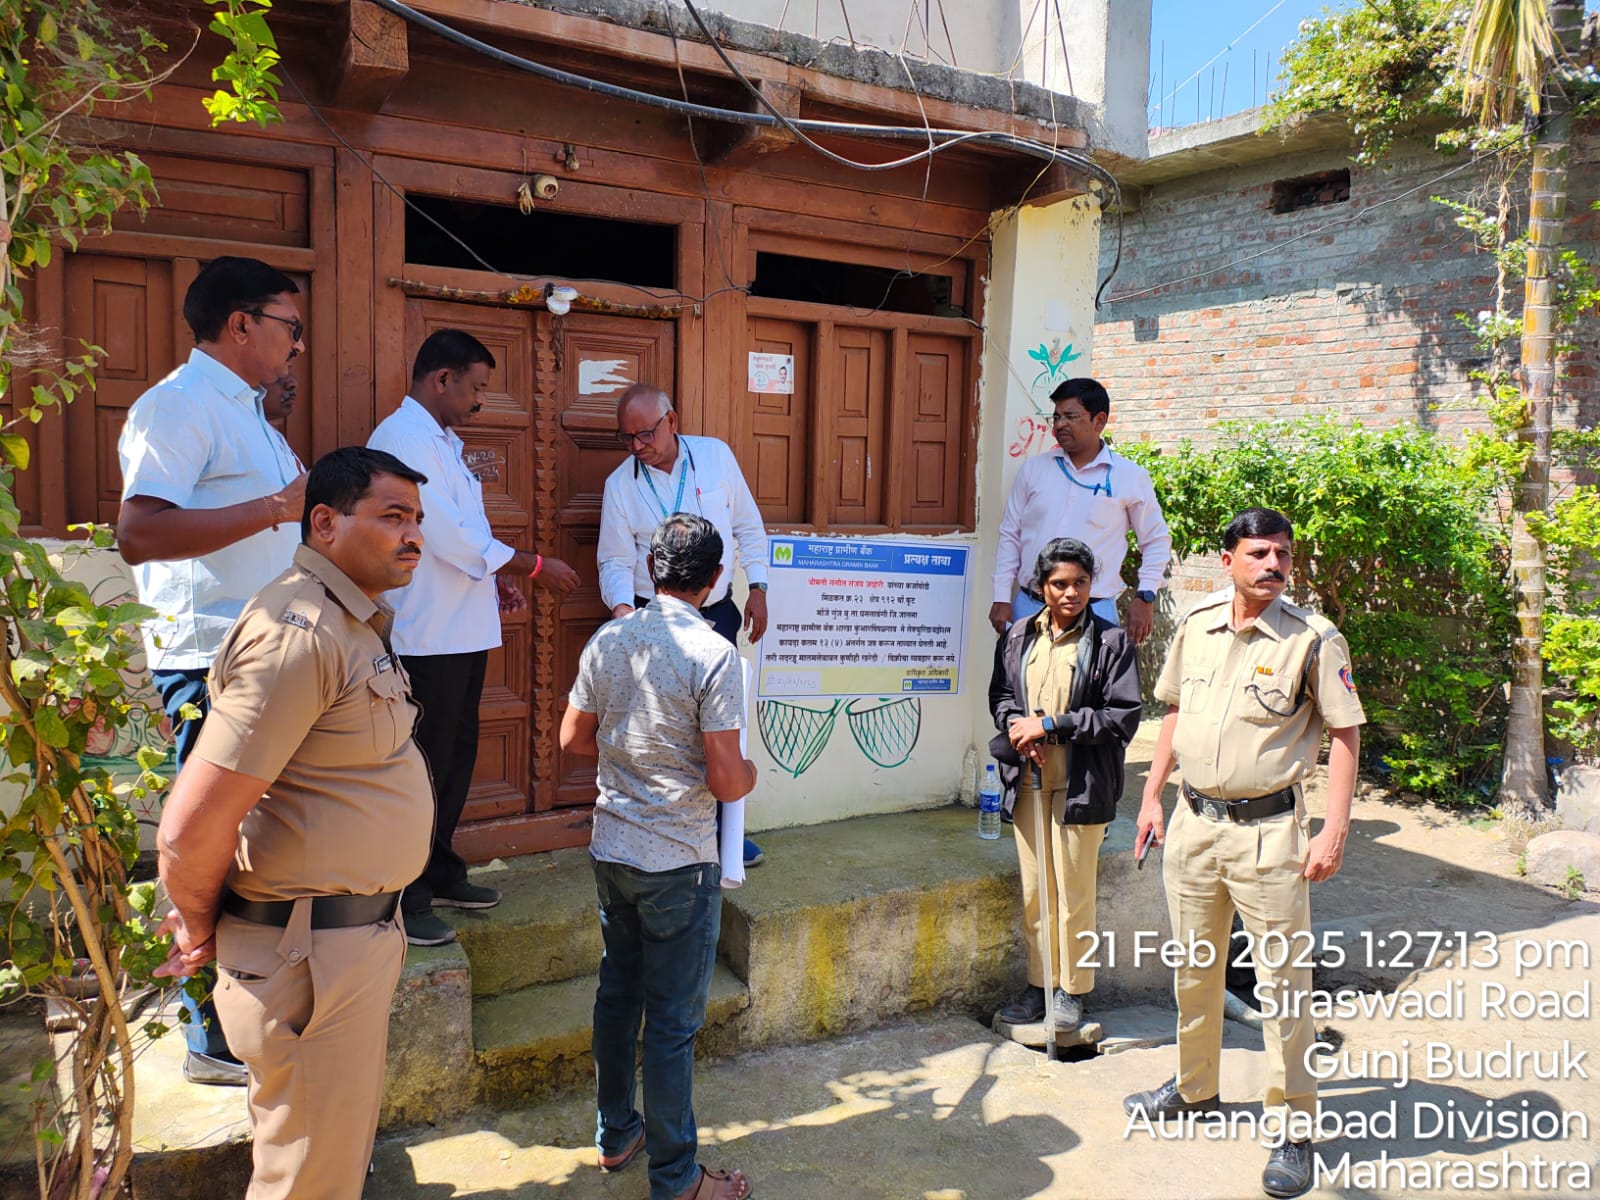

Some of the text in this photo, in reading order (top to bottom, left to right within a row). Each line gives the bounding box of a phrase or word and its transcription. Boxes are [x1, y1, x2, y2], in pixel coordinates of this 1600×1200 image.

[798, 559, 840, 567] MAHARASHTRA
[904, 553, 951, 567] प्रत्यक्ष ताबा
